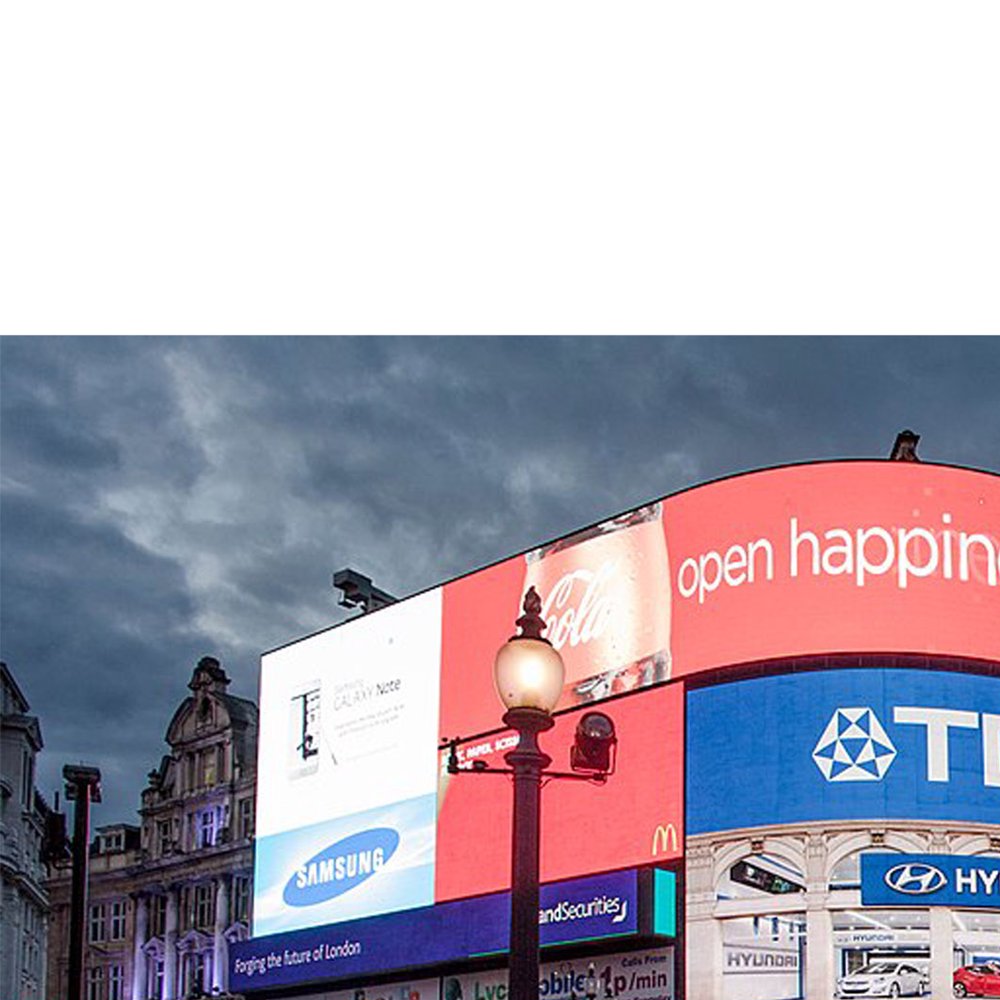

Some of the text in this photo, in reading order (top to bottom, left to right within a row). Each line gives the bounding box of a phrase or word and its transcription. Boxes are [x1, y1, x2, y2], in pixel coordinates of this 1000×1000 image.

[678, 536, 774, 604] open
[376, 678, 401, 695] Note
[296, 847, 384, 889] SAMSUNG
[539, 896, 620, 925] andSecurities
[234, 940, 361, 976] Forging the future of London
[727, 953, 798, 968] HYUNDAI
